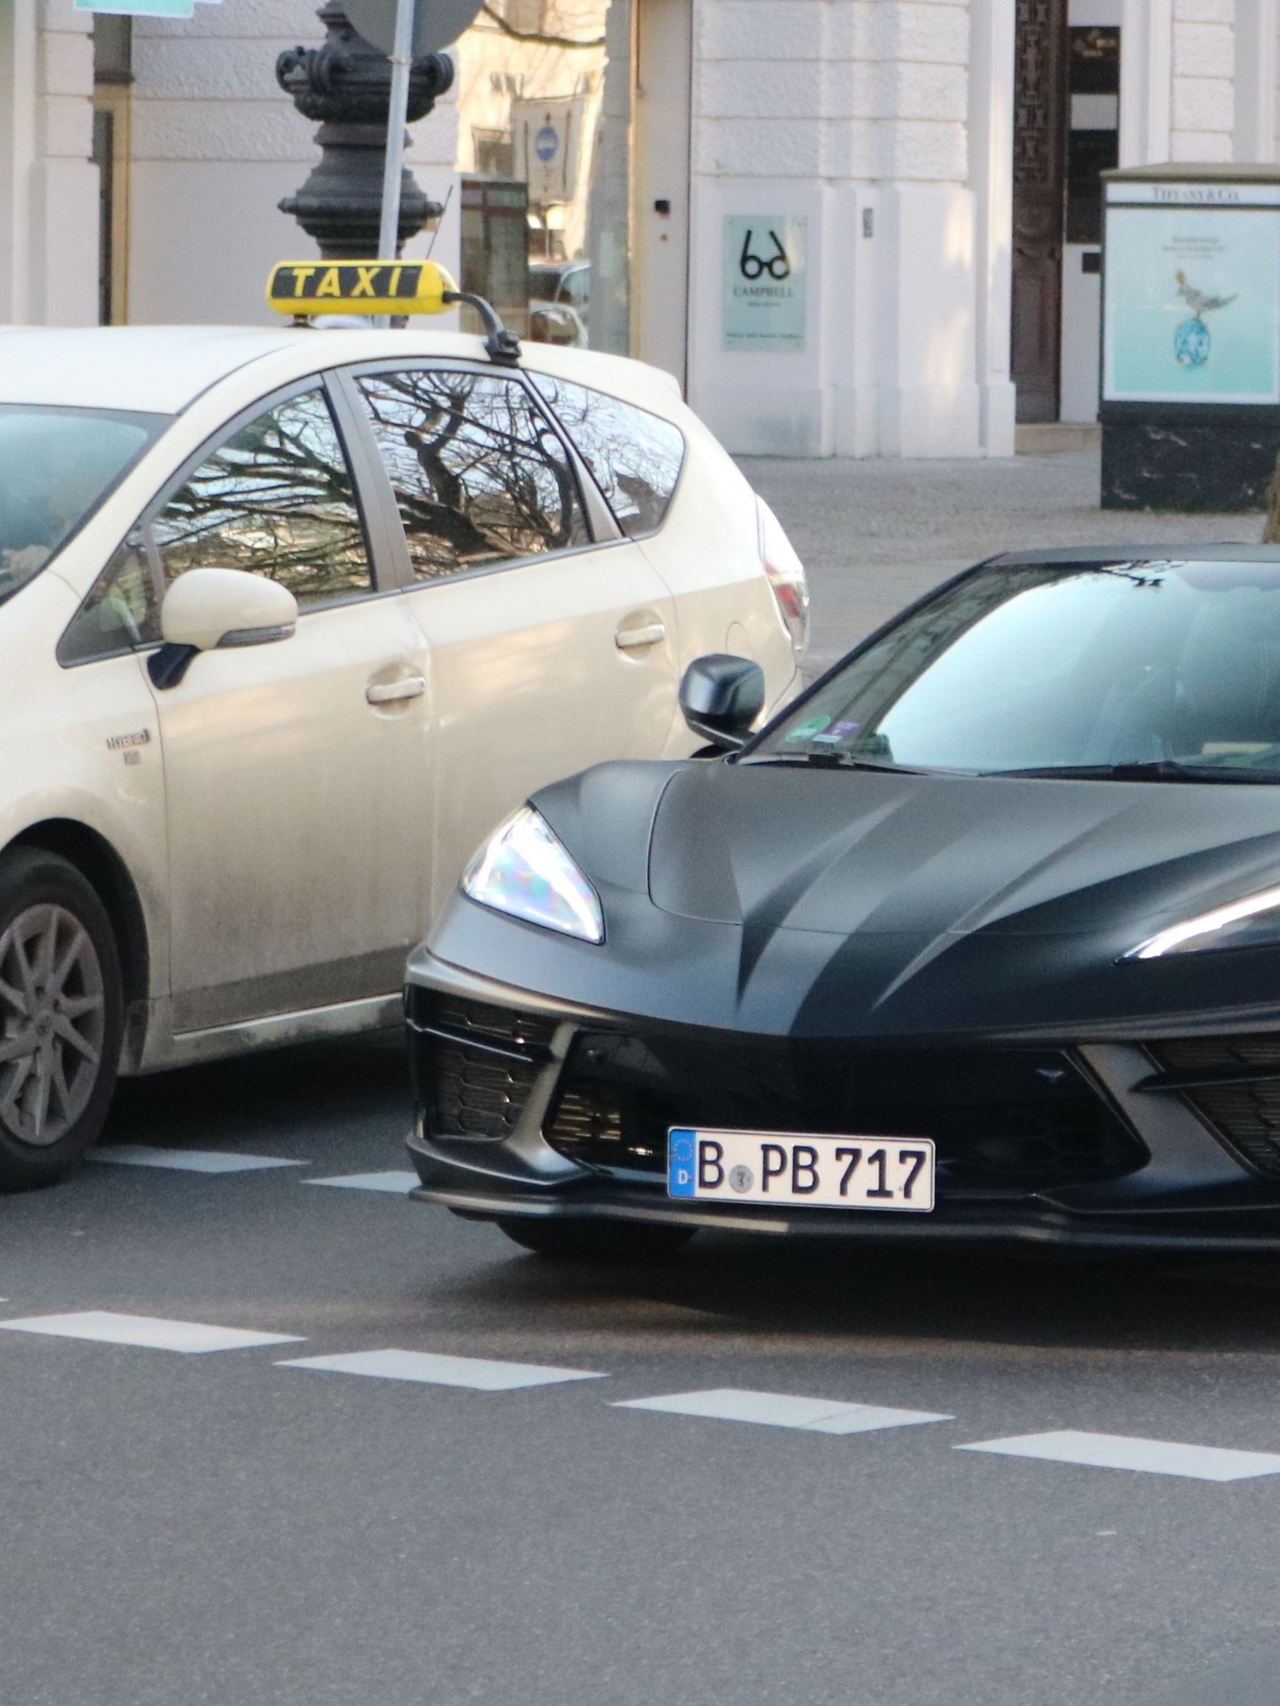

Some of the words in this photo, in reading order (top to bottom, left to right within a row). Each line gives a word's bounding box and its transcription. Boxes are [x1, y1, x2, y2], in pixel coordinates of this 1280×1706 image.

[292, 267, 402, 298] TAXI
[733, 286, 795, 298] CAMPBELL
[677, 1169, 688, 1185] D
[698, 1140, 726, 1190] B
[760, 1143, 821, 1195] PB
[835, 1146, 927, 1200] 717
